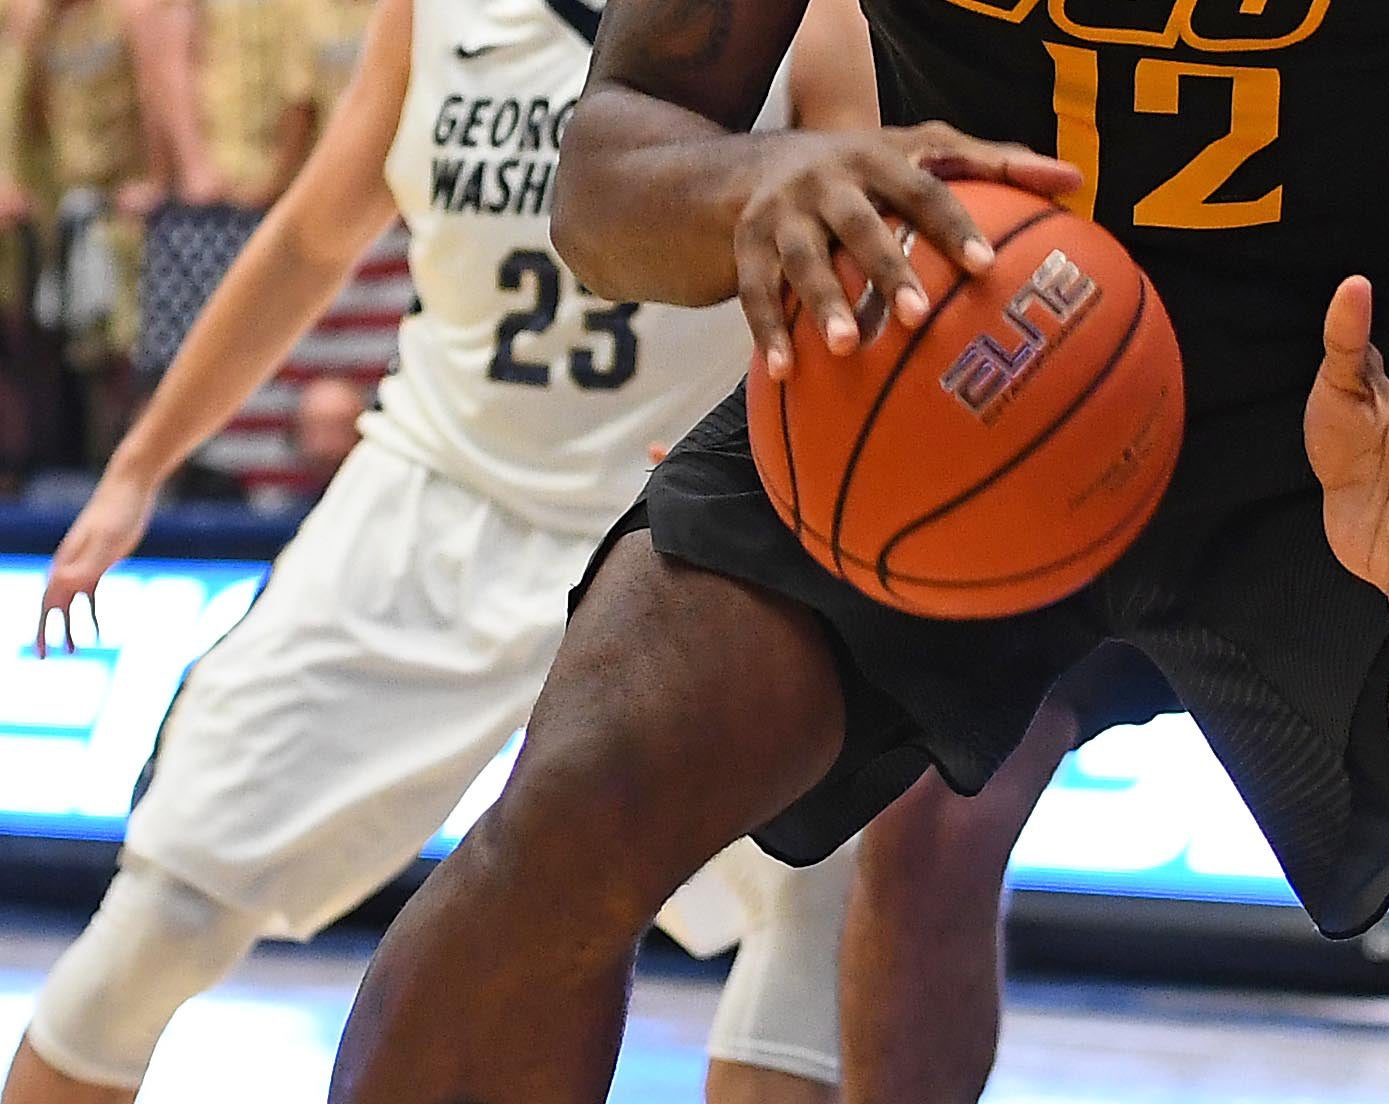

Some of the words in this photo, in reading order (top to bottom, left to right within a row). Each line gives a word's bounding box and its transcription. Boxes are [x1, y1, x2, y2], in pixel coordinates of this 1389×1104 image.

[430, 157, 553, 215] WASH
[1041, 40, 1283, 230] 12
[486, 248, 639, 390] 23
